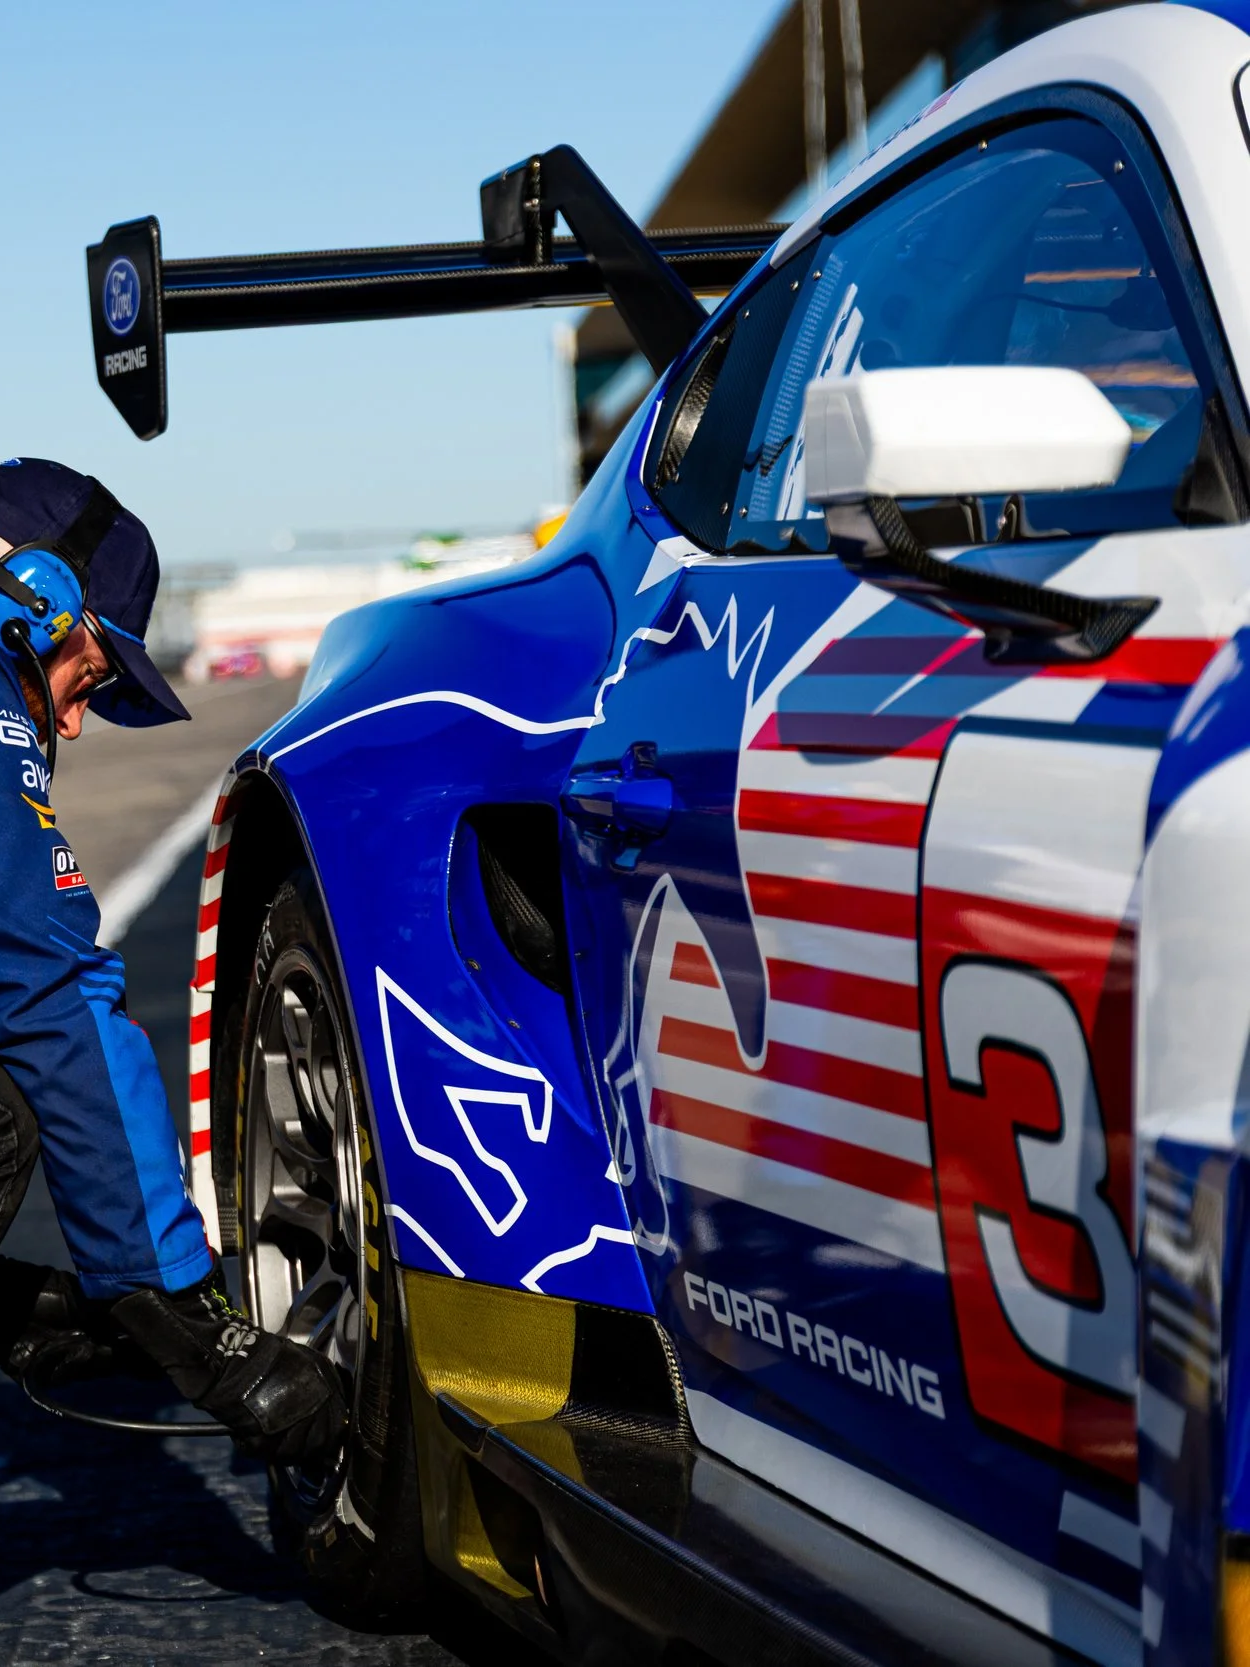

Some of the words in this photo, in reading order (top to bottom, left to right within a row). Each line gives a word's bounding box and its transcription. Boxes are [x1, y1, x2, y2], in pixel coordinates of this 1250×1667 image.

[111, 270, 134, 321] Ford
[104, 344, 148, 377] RACING
[940, 954, 1138, 1404] 3
[683, 1270, 784, 1349] FORD
[786, 1310, 946, 1420] RACING
